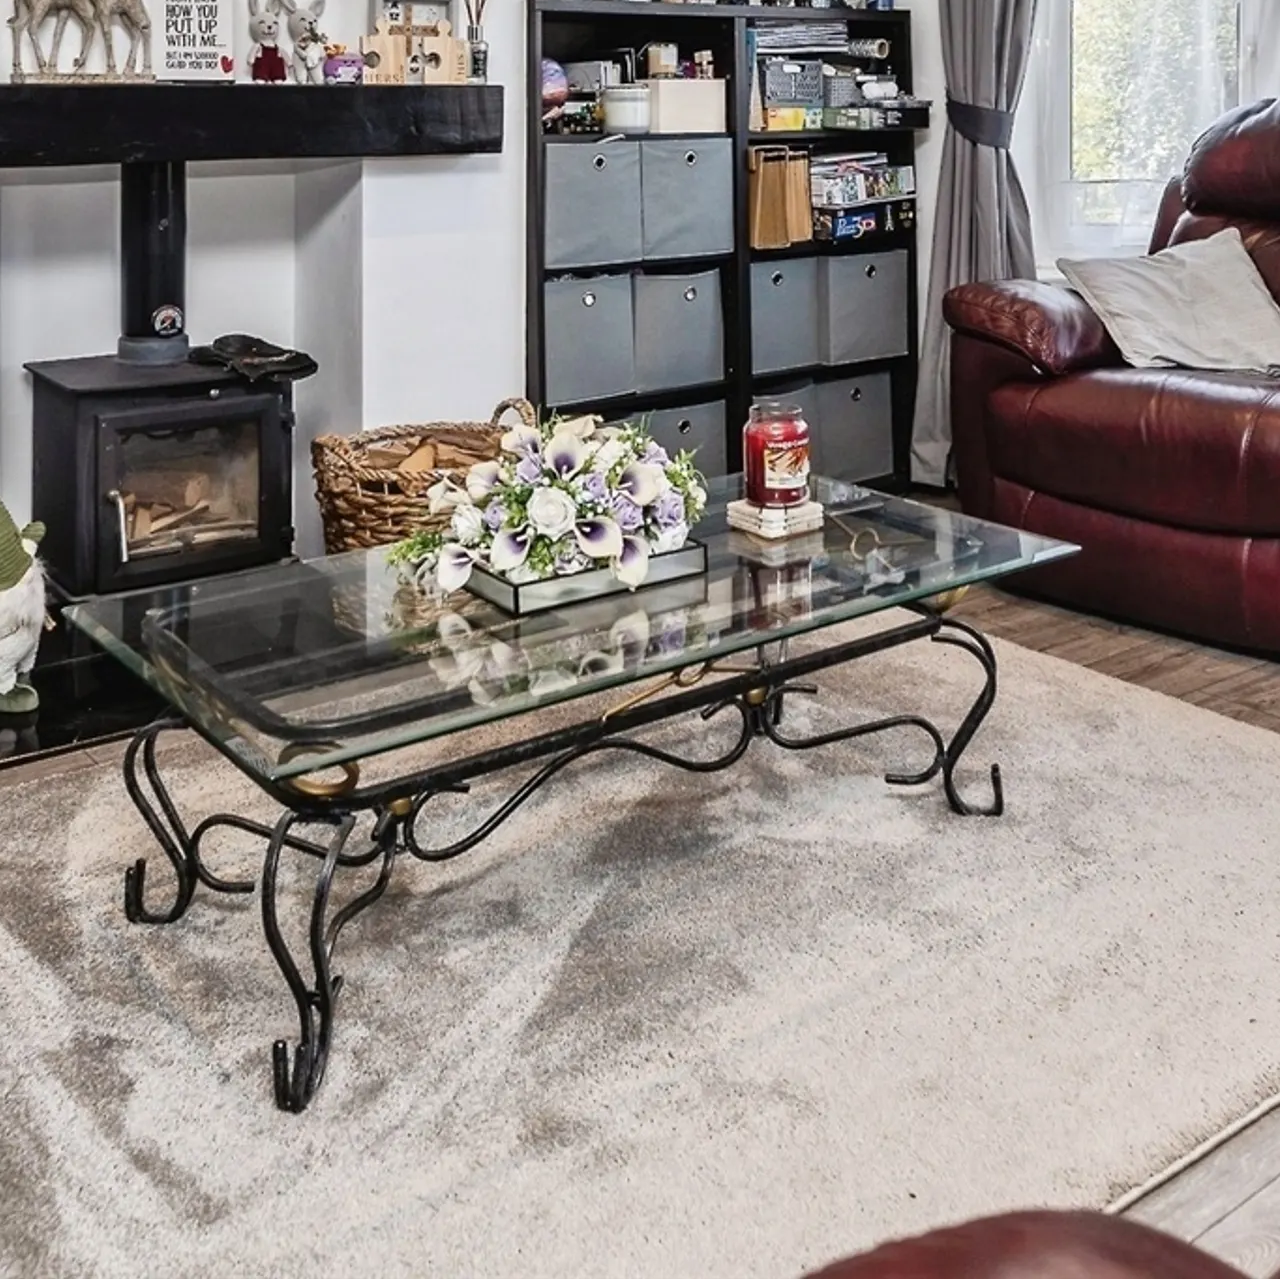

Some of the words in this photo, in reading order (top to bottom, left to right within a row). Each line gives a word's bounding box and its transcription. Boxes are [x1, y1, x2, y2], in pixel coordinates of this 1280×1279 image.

[166, 5, 193, 18] HOW
[196, 5, 217, 18] YOU
[166, 18, 193, 33] PUT
[198, 19, 217, 33] UP
[166, 34, 196, 47] WITH
